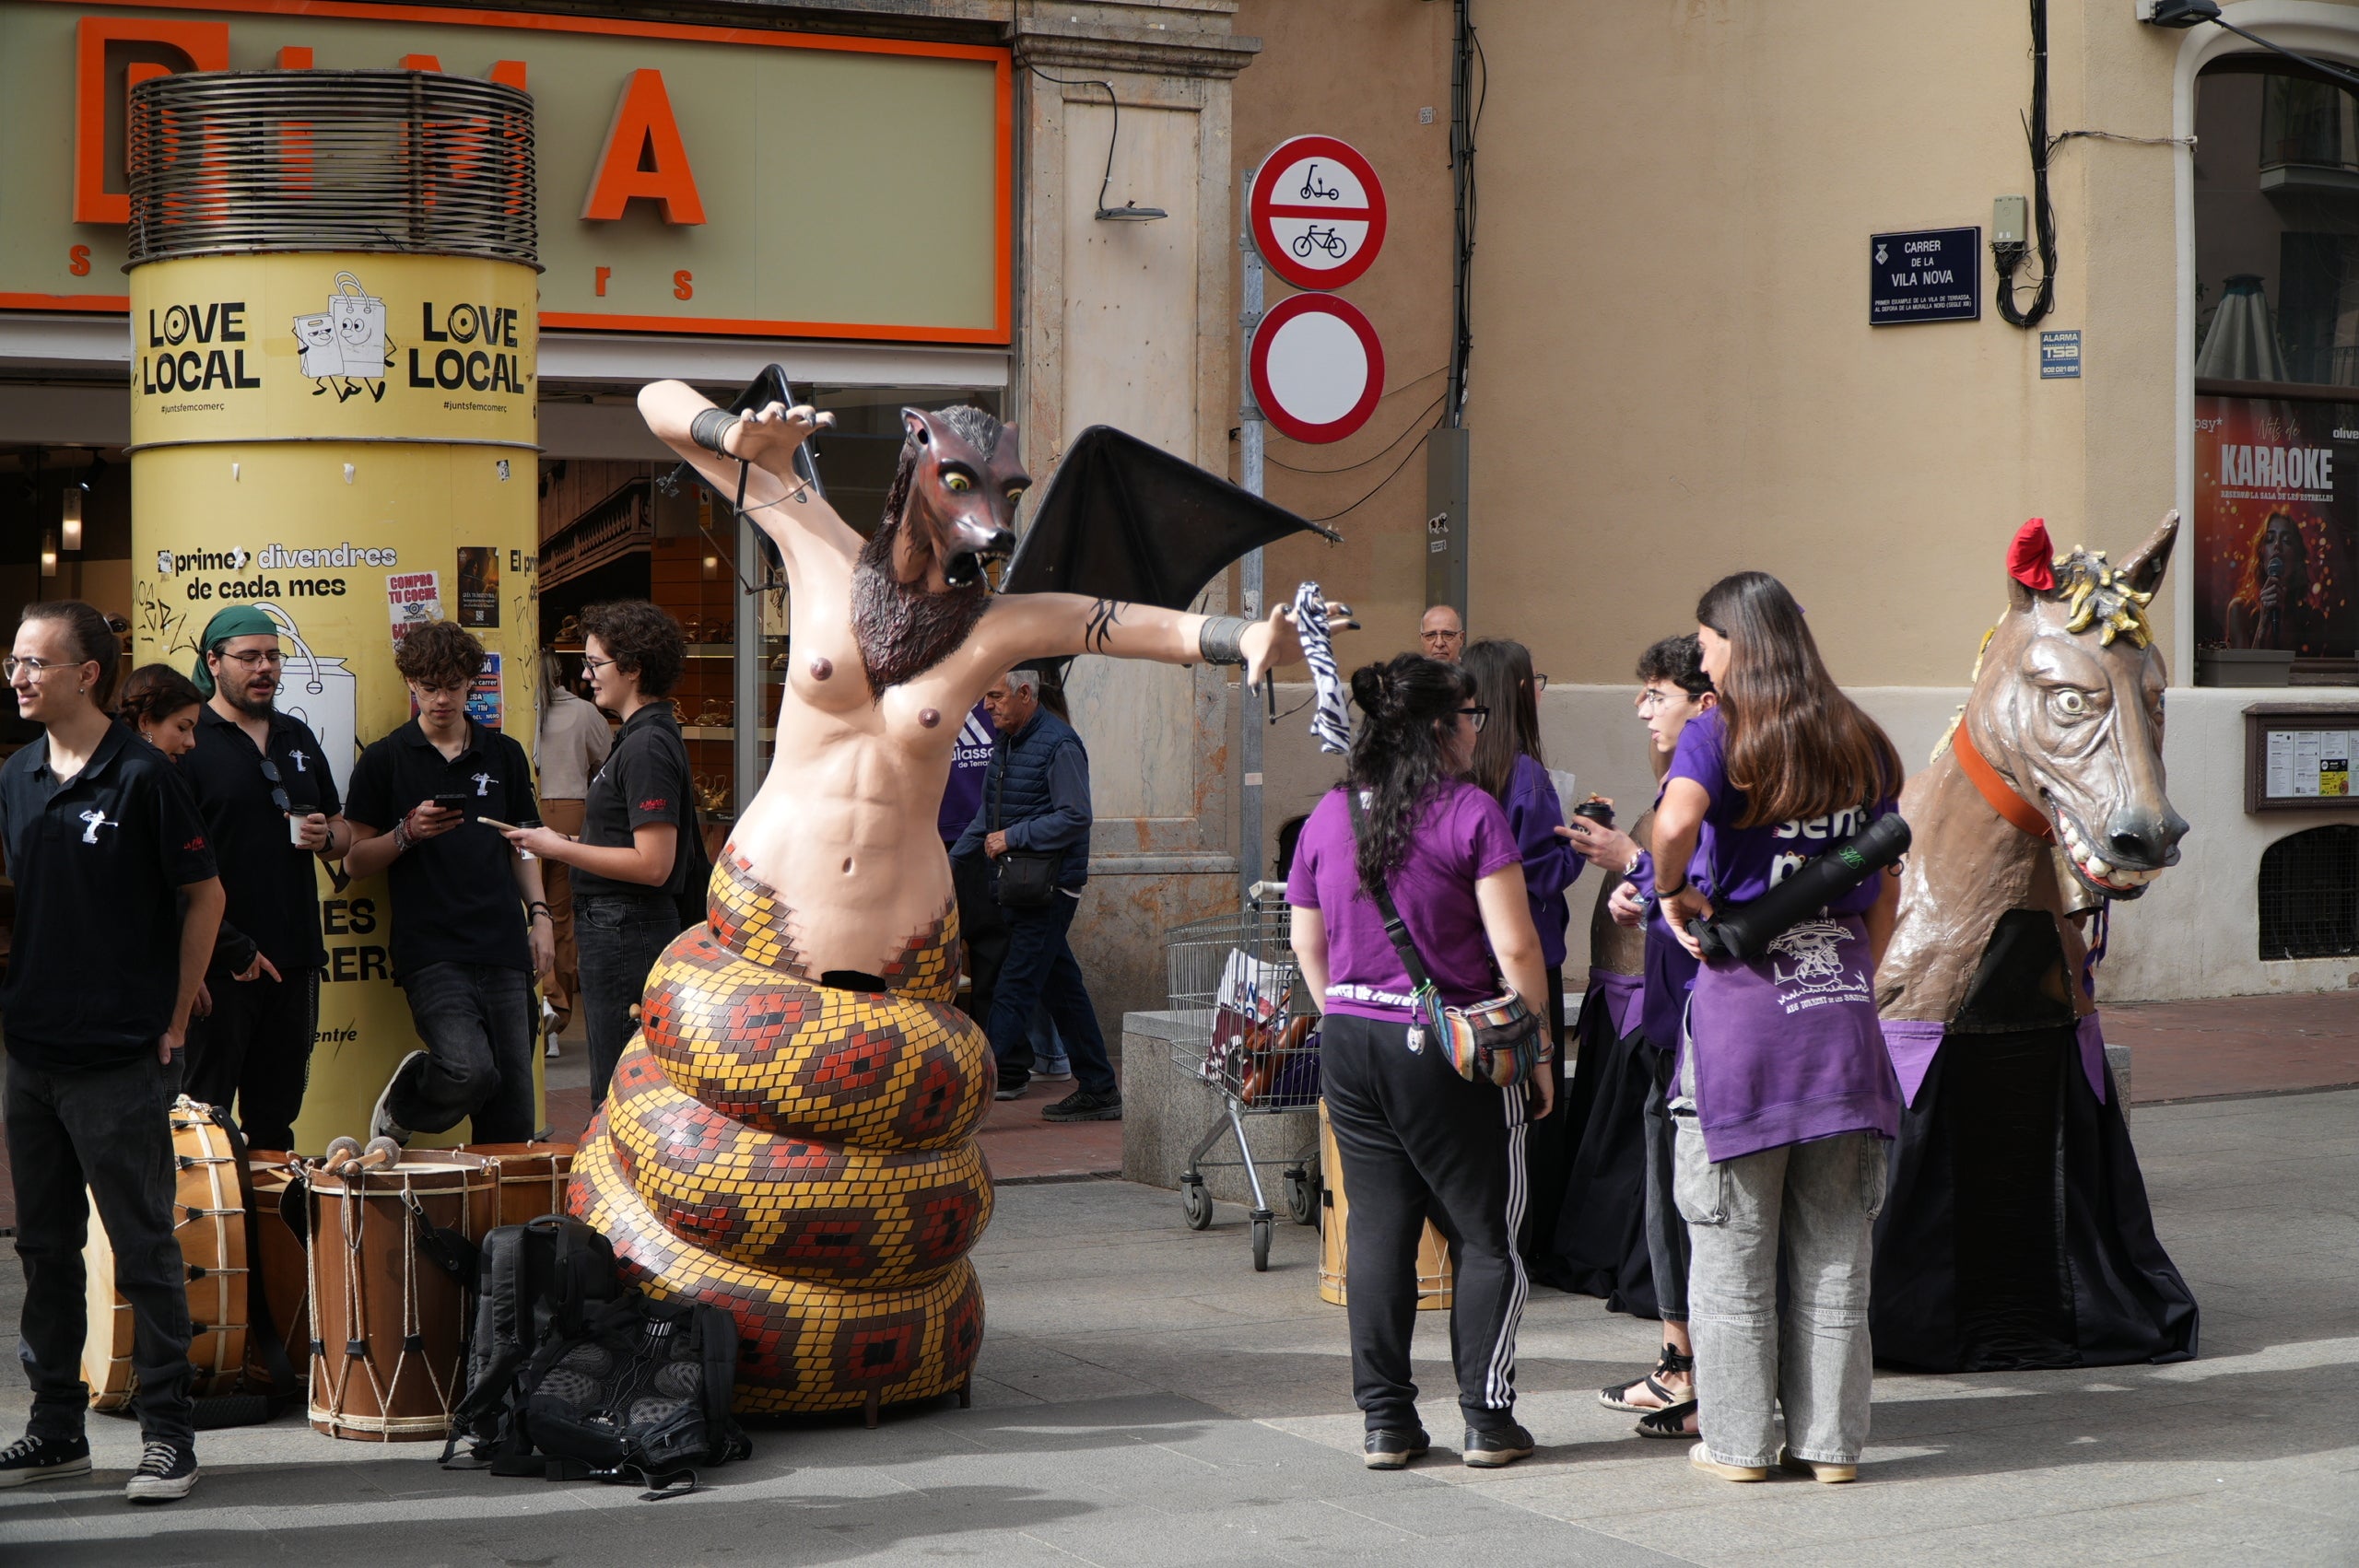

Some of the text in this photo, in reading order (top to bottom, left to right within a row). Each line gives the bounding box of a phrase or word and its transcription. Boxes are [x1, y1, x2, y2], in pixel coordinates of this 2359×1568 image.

[1904, 240, 1941, 253] CARRER
[1911, 257, 1934, 267] DE LA
[1892, 270, 1954, 287] VILA NOVA
[150, 302, 245, 347] LOVE
[423, 302, 518, 348] LOVE
[2043, 333, 2078, 342] ALARMA
[144, 349, 261, 395] LOCAL
[409, 348, 524, 394] LOCAL
[161, 403, 225, 415] #juntsfemcomerç
[443, 401, 507, 413] #juntsfemcomerç
[2222, 444, 2333, 490] KARAOKE
[2288, 493, 2299, 501] LES
[2300, 493, 2334, 502] ESTRELLES
[257, 542, 397, 569] divendres
[510, 550, 521, 572] El
[187, 575, 346, 600] de cada mes
[390, 573, 433, 590] COMPRO
[388, 587, 438, 604] TU COCHE
[314, 1028, 358, 1042] entre
